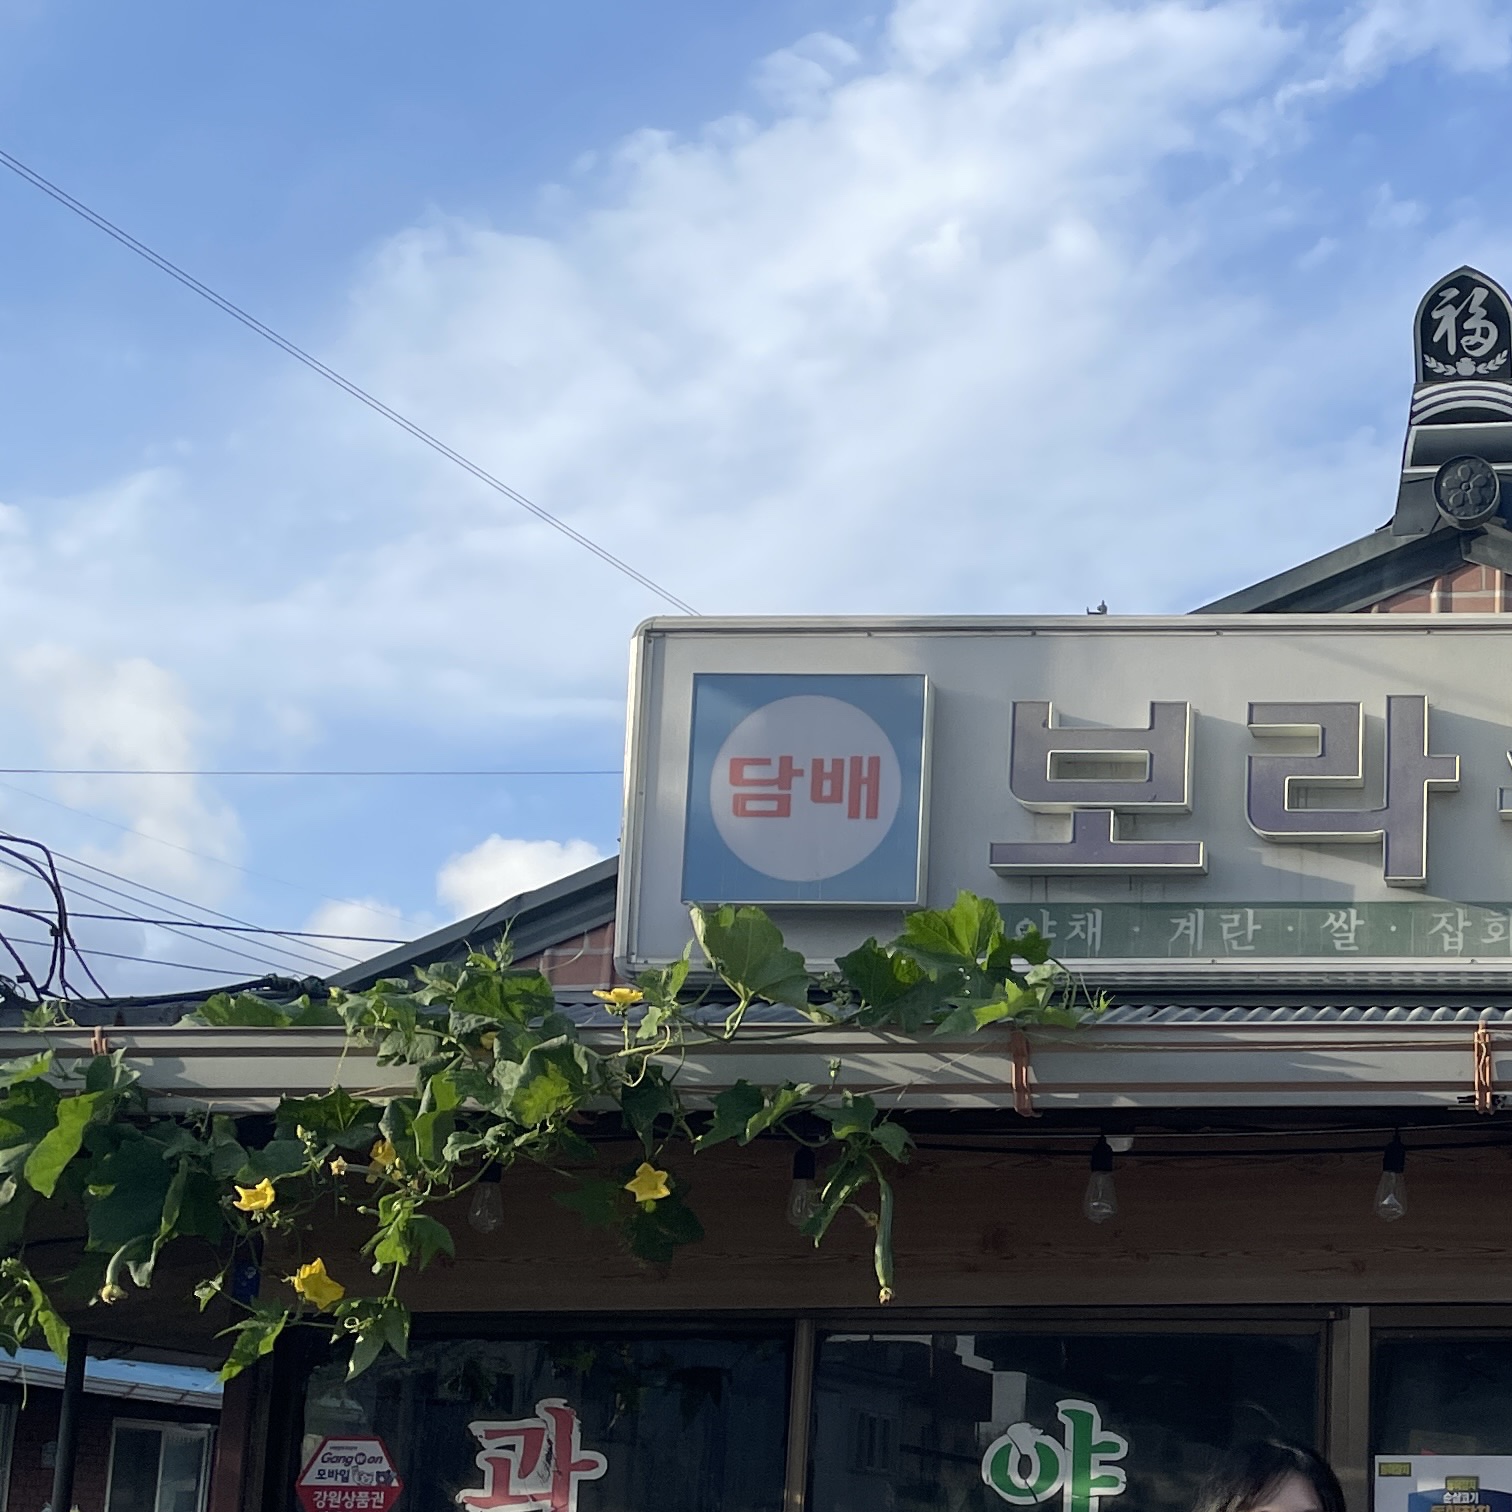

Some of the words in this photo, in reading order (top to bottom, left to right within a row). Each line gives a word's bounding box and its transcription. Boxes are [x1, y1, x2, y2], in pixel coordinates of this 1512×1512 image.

[1431, 286, 1498, 357] 福
[728, 754, 881, 820] 담배
[1015, 908, 1103, 951] 야채
[1170, 908, 1262, 951] 계란
[1321, 908, 1365, 951] 쌀
[313, 1490, 385, 1510] 강원상품권
